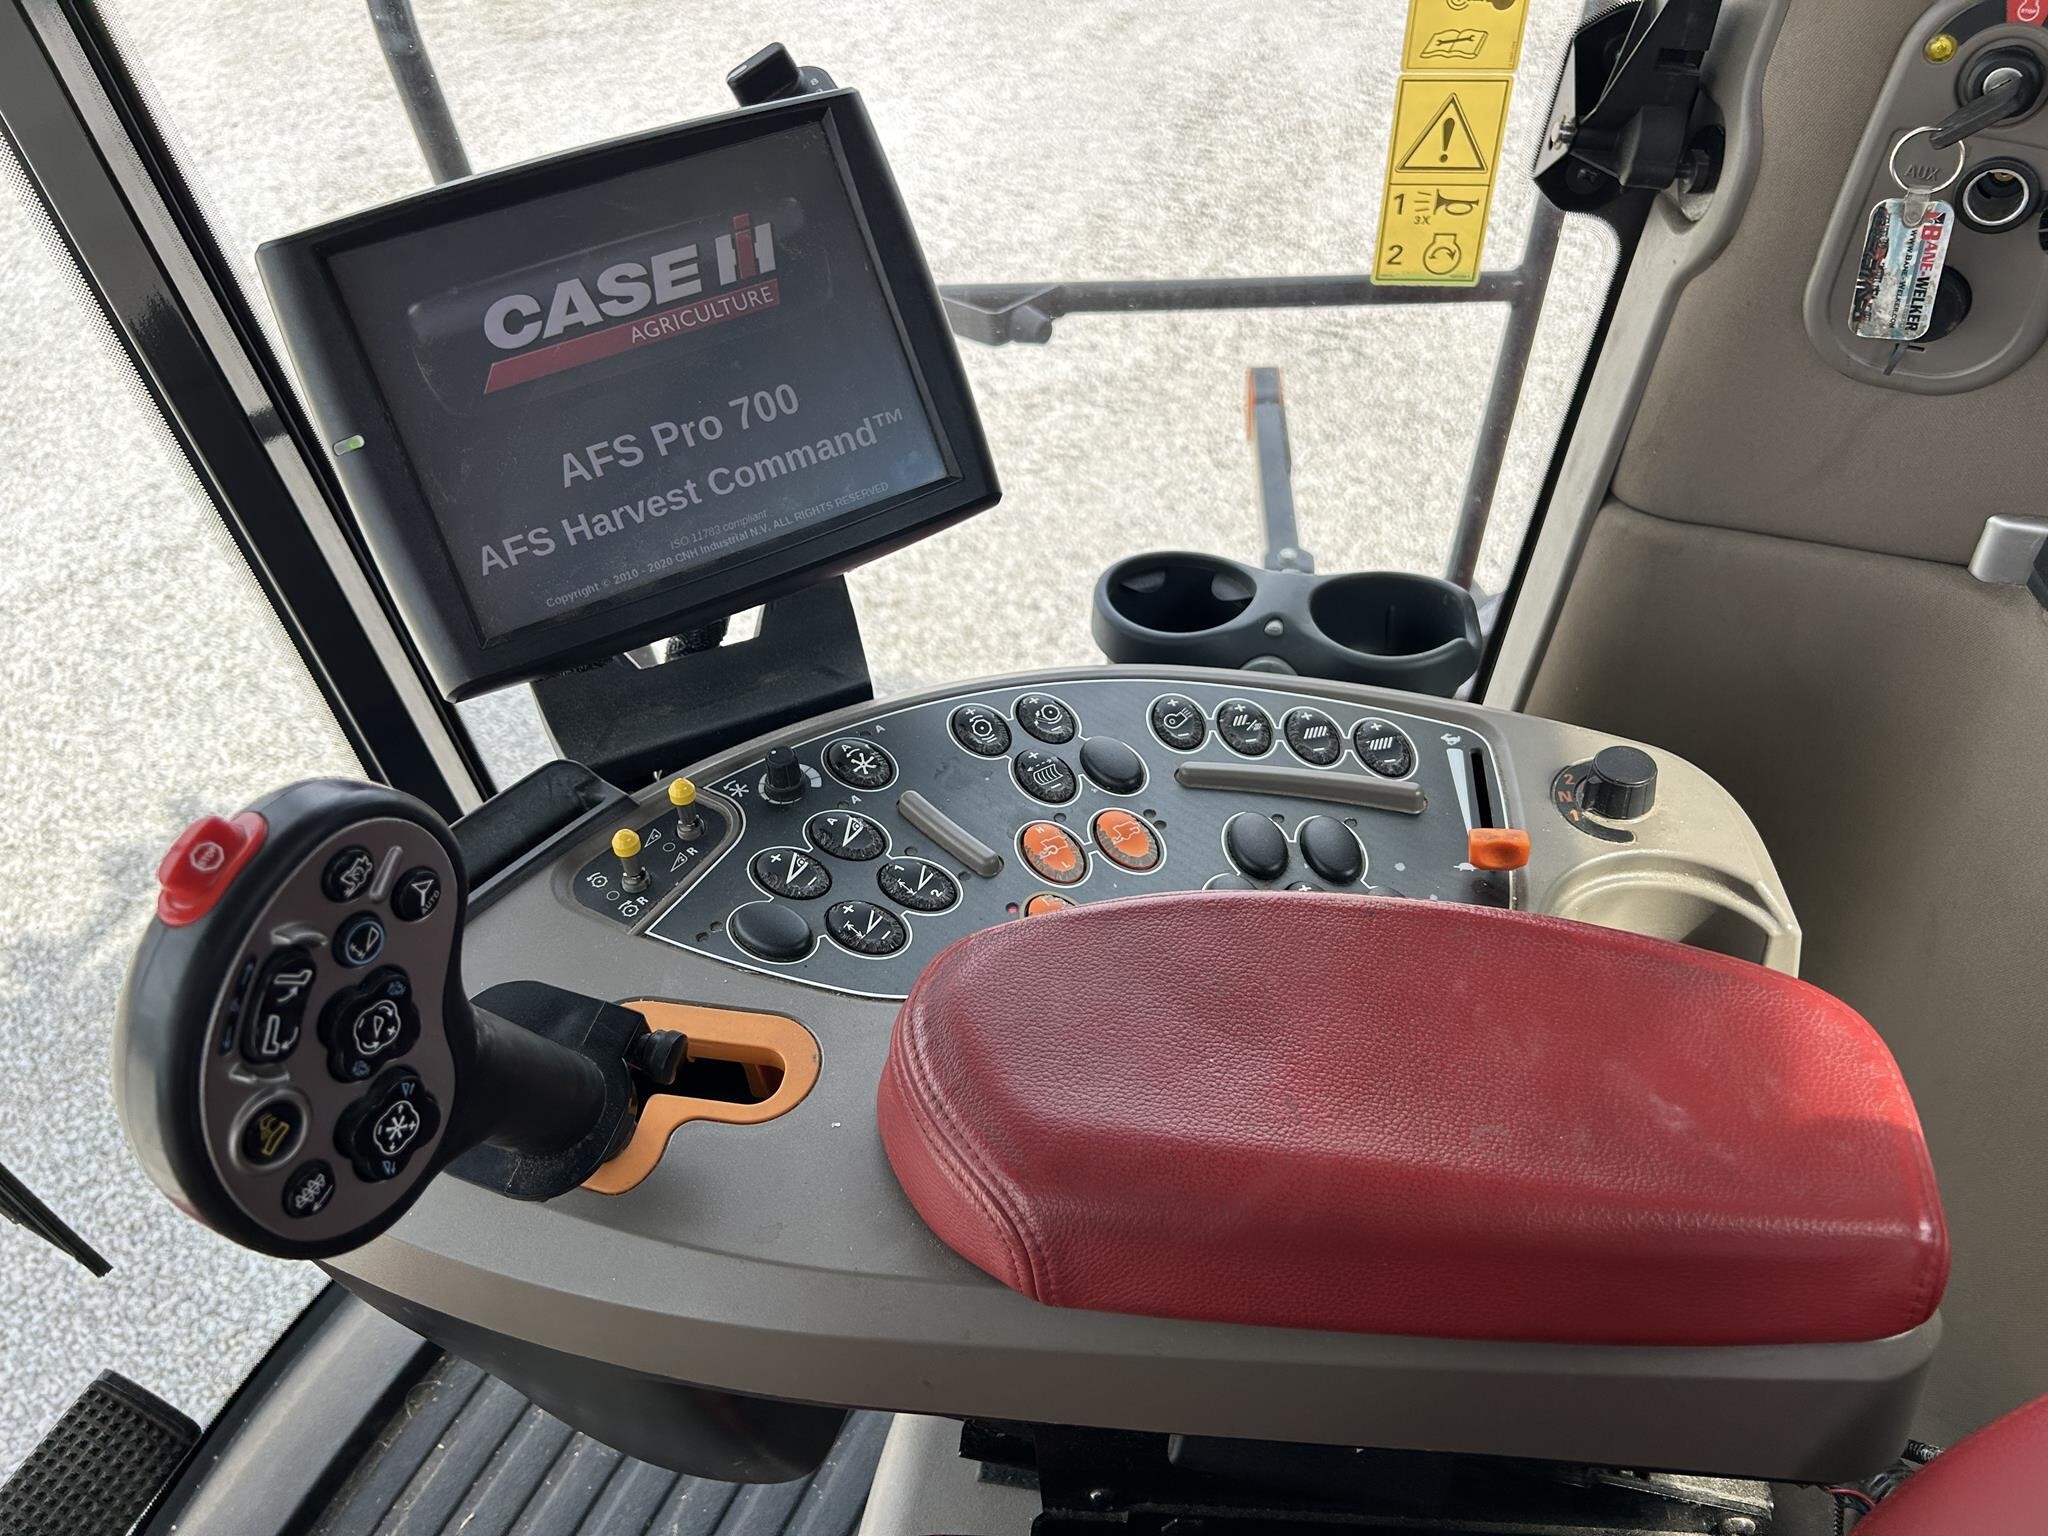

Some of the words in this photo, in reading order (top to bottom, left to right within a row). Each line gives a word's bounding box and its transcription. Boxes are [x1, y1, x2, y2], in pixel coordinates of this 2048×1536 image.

[1903, 164, 1941, 182] AUX
[1393, 193, 1405, 215] 1
[1413, 215, 1431, 225] 3X
[1386, 244, 1404, 265] 2
[484, 243, 702, 349] CASE
[714, 213, 776, 286] IH
[1905, 224, 1944, 332] BANE-WELKER
[631, 285, 775, 344] AGRICULTURE
[562, 434, 645, 489] AFS
[650, 415, 723, 457] Pro
[728, 383, 799, 430] 700
[480, 527, 557, 577] AFS
[561, 479, 703, 546] Harvest
[670, 536, 691, 550] ISO
[692, 524, 722, 543] 11783
[722, 509, 768, 533] compliant
[546, 582, 601, 608] Copyright
[613, 568, 640, 585] 2010
[648, 556, 674, 574] 2020
[675, 545, 700, 563] CNH
[700, 529, 750, 554] Industrial
[749, 523, 772, 539] N.V.
[773, 514, 793, 530] ALL
[794, 501, 834, 521] RIGHTS
[834, 481, 889, 507] RESERVED
[875, 724, 886, 734] A
[841, 744, 852, 753] A
[1563, 773, 1576, 785] 2
[851, 794, 862, 805] A
[1557, 790, 1573, 803] N
[826, 817, 838, 826] A
[1569, 808, 1580, 822] 1
[686, 846, 699, 856] R
[894, 863, 905, 872] 1
[930, 888, 944, 898] 2
[421, 889, 441, 915] AUTO
[636, 895, 649, 906] R
